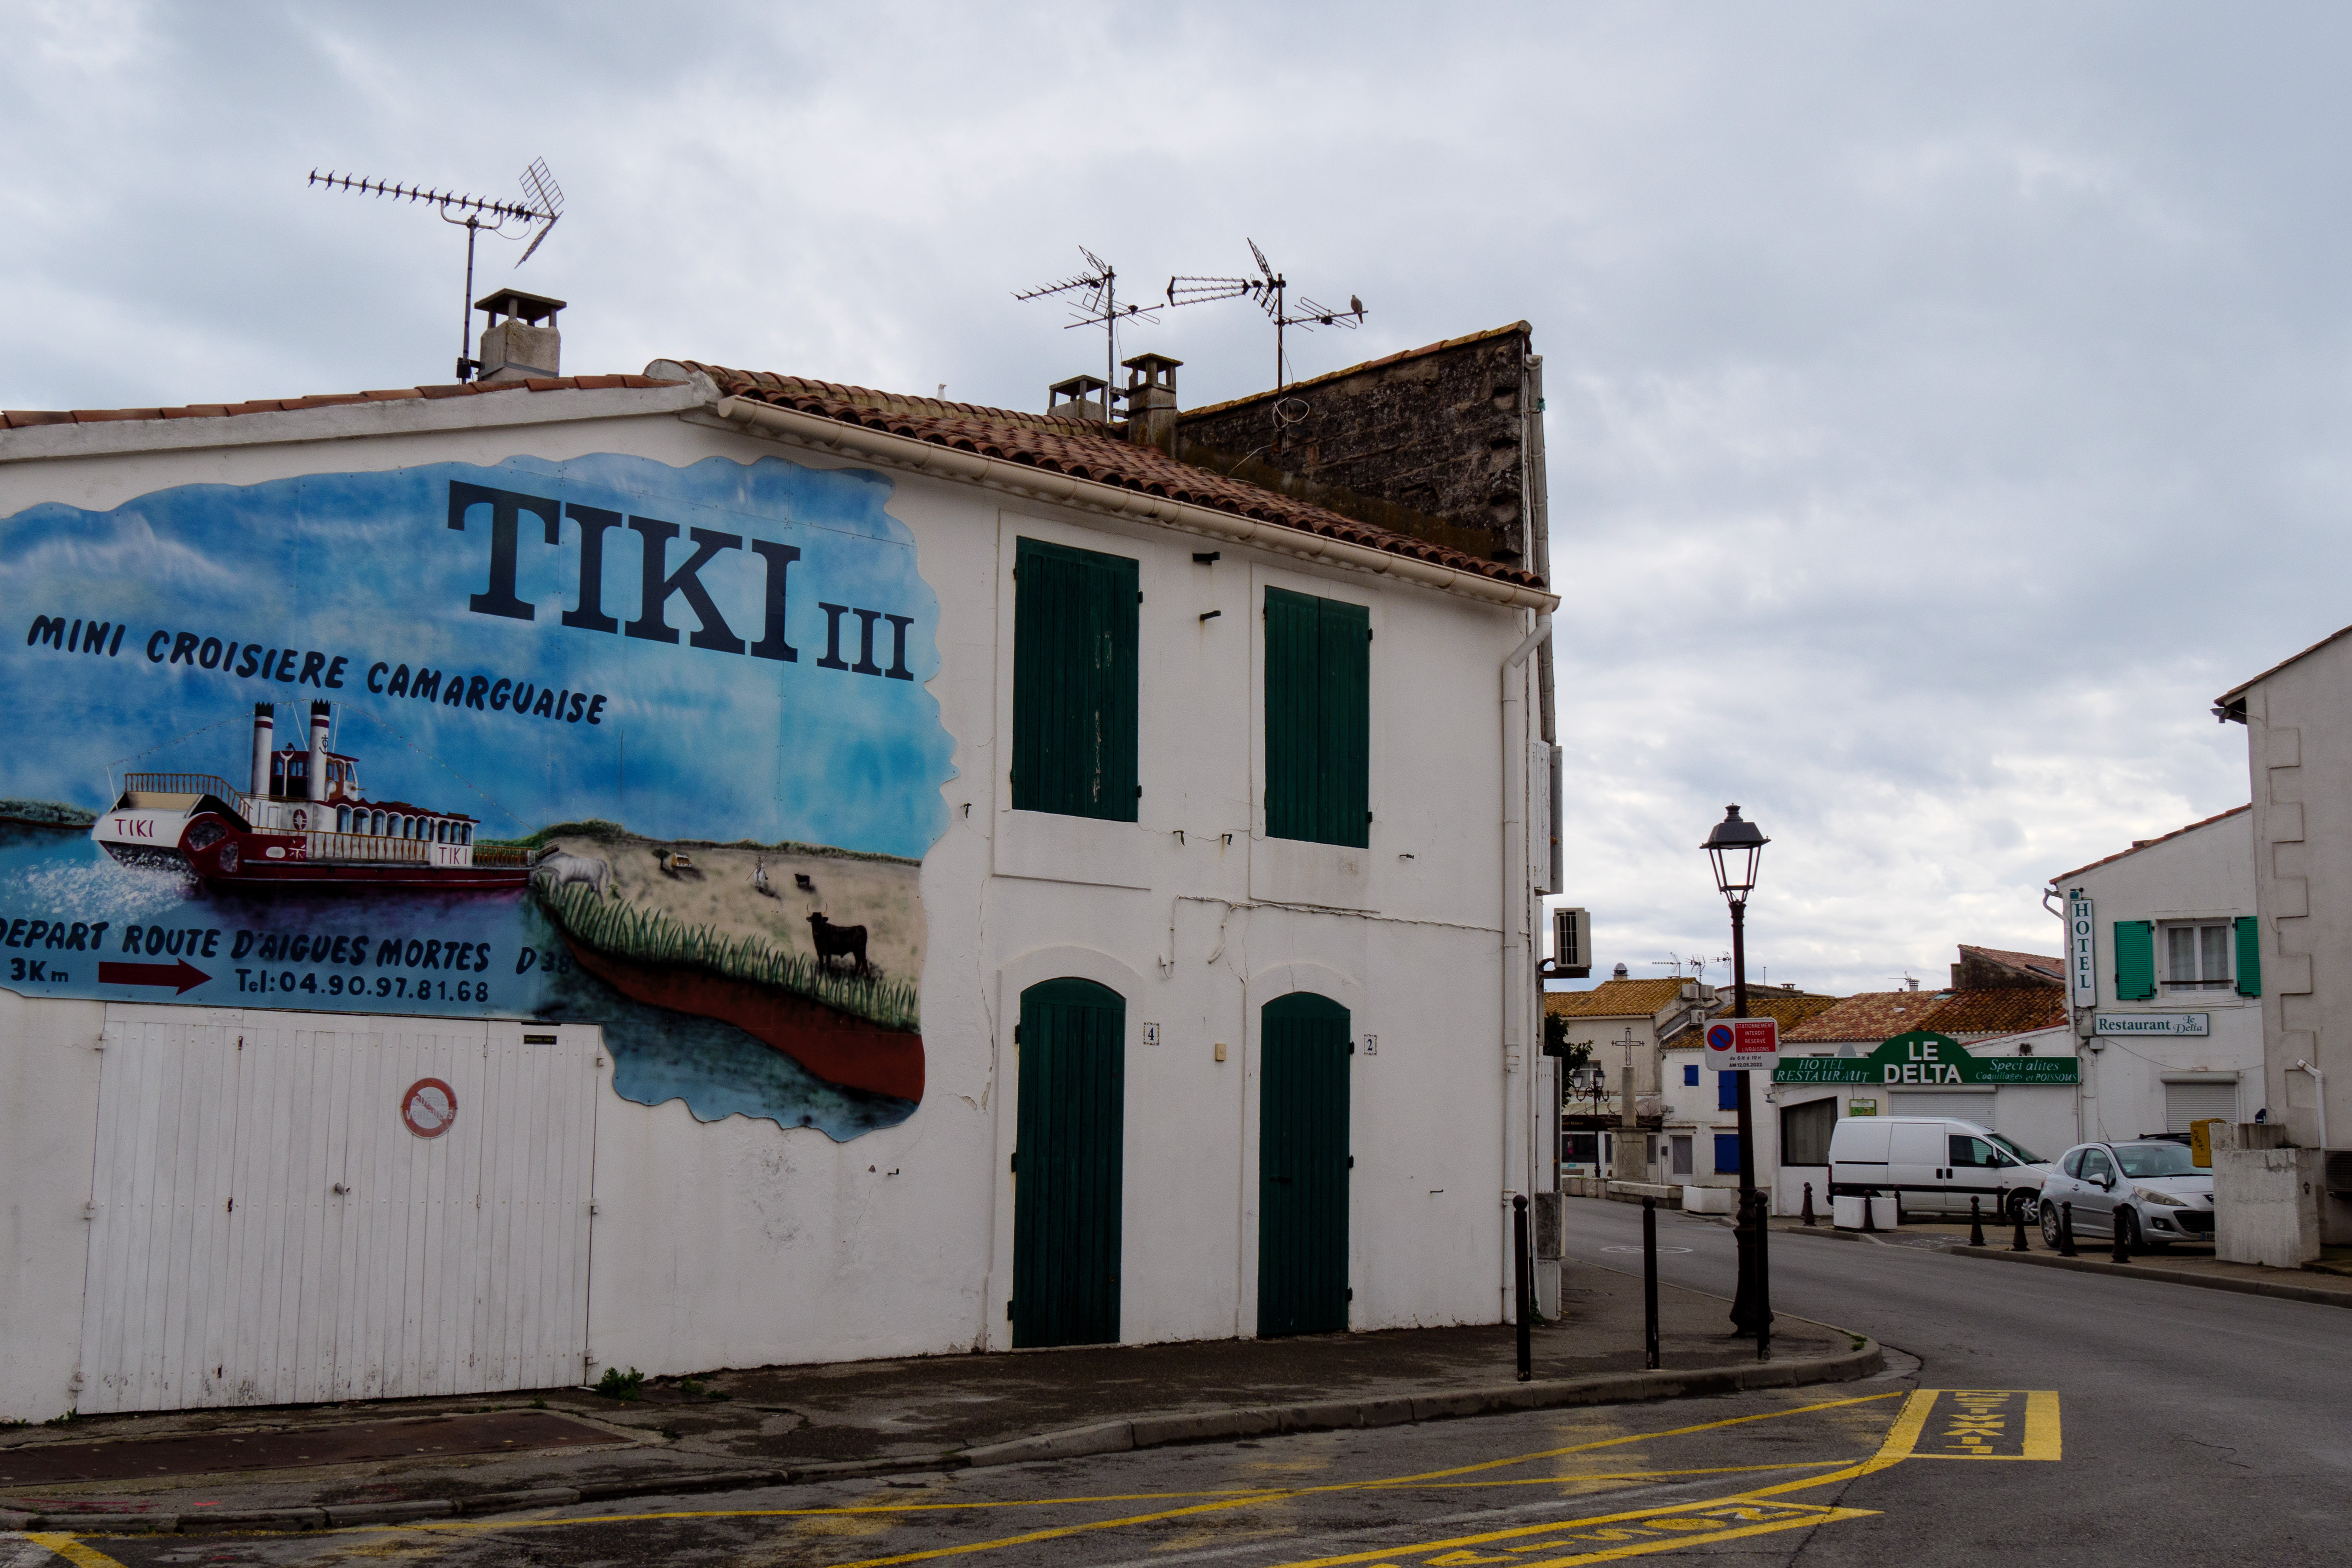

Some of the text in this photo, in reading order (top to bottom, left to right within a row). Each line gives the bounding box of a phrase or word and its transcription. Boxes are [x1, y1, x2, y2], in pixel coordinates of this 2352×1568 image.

[447, 480, 915, 682] TIKI III
[27, 614, 608, 725] MINI CROISIERE CAMARGUAISE
[114, 819, 153, 838] TIKI
[439, 846, 468, 866] TIKI
[122, 925, 221, 957] ROUTE
[230, 930, 369, 966] D'AIGUES
[376, 938, 491, 972] MORTES
[2074, 903, 2090, 988] HOTEL
[2098, 1018, 2202, 1034] Restaurant Delta
[2183, 1015, 2195, 1024] Le
[1148, 1027, 1154, 1041] 4
[1367, 1039, 1373, 1051] 2
[1908, 1041, 1939, 1061] LE
[1799, 1060, 1844, 1069] HOTEL
[1884, 1064, 1963, 1084] DELTA
[1976, 1072, 2023, 1081] Coquillages
[414, 1096, 445, 1106] SORTIE
